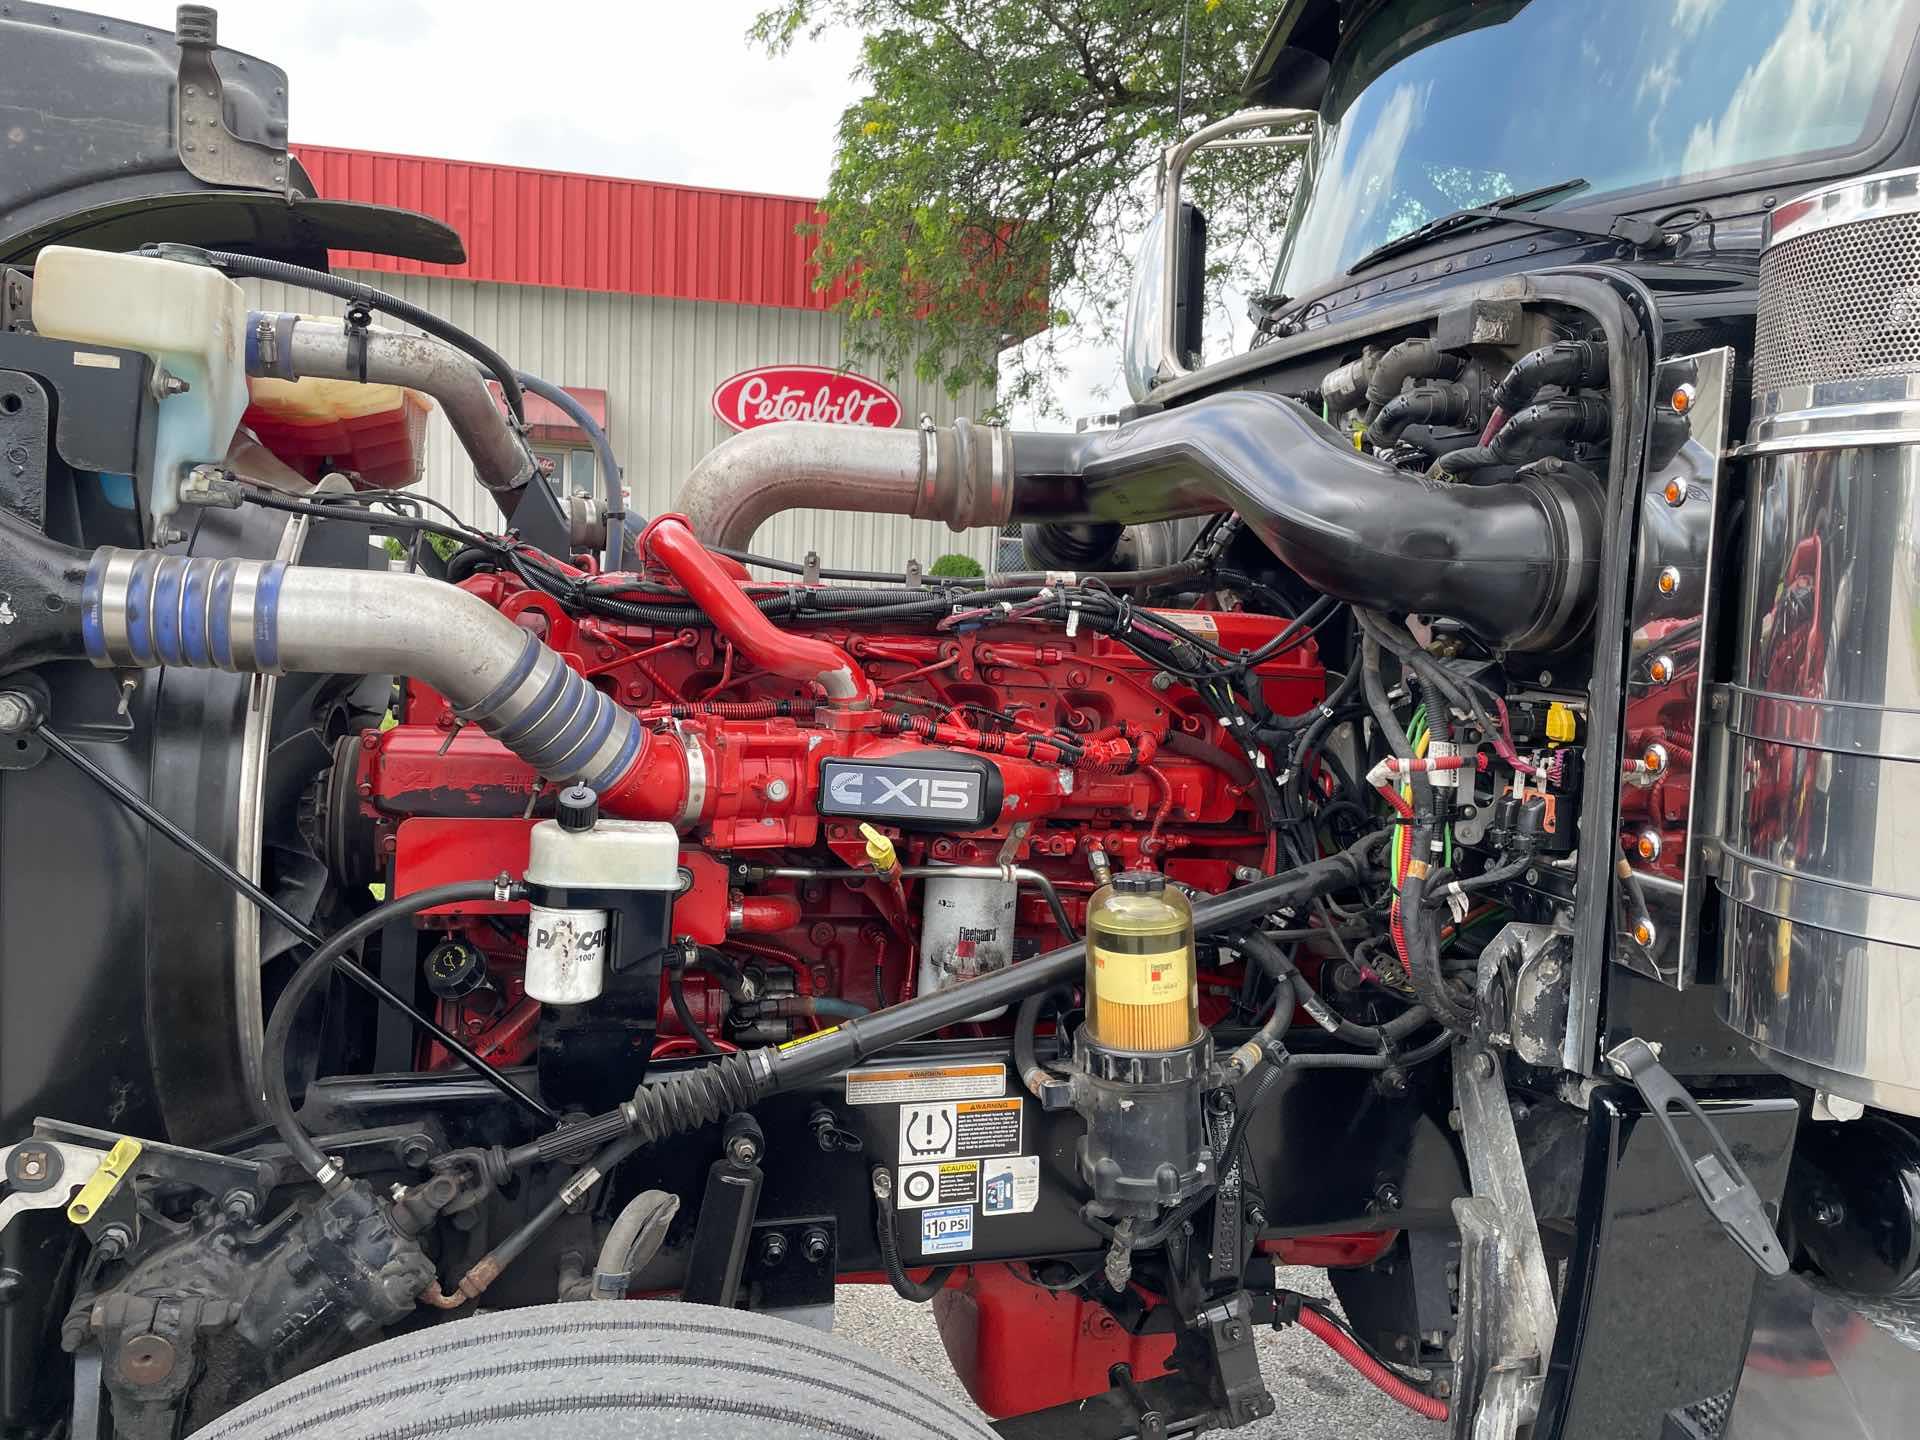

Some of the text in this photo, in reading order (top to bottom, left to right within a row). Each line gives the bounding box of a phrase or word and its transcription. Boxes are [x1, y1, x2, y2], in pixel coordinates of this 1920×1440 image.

[737, 377, 888, 426] Peterbilt
[872, 776, 969, 810] X15
[959, 926, 997, 945] Fleetguard
[975, 1102, 1008, 1110] WARNING
[945, 1164, 977, 1172] CAUTION
[926, 1218, 968, 1236] 110 PSI
